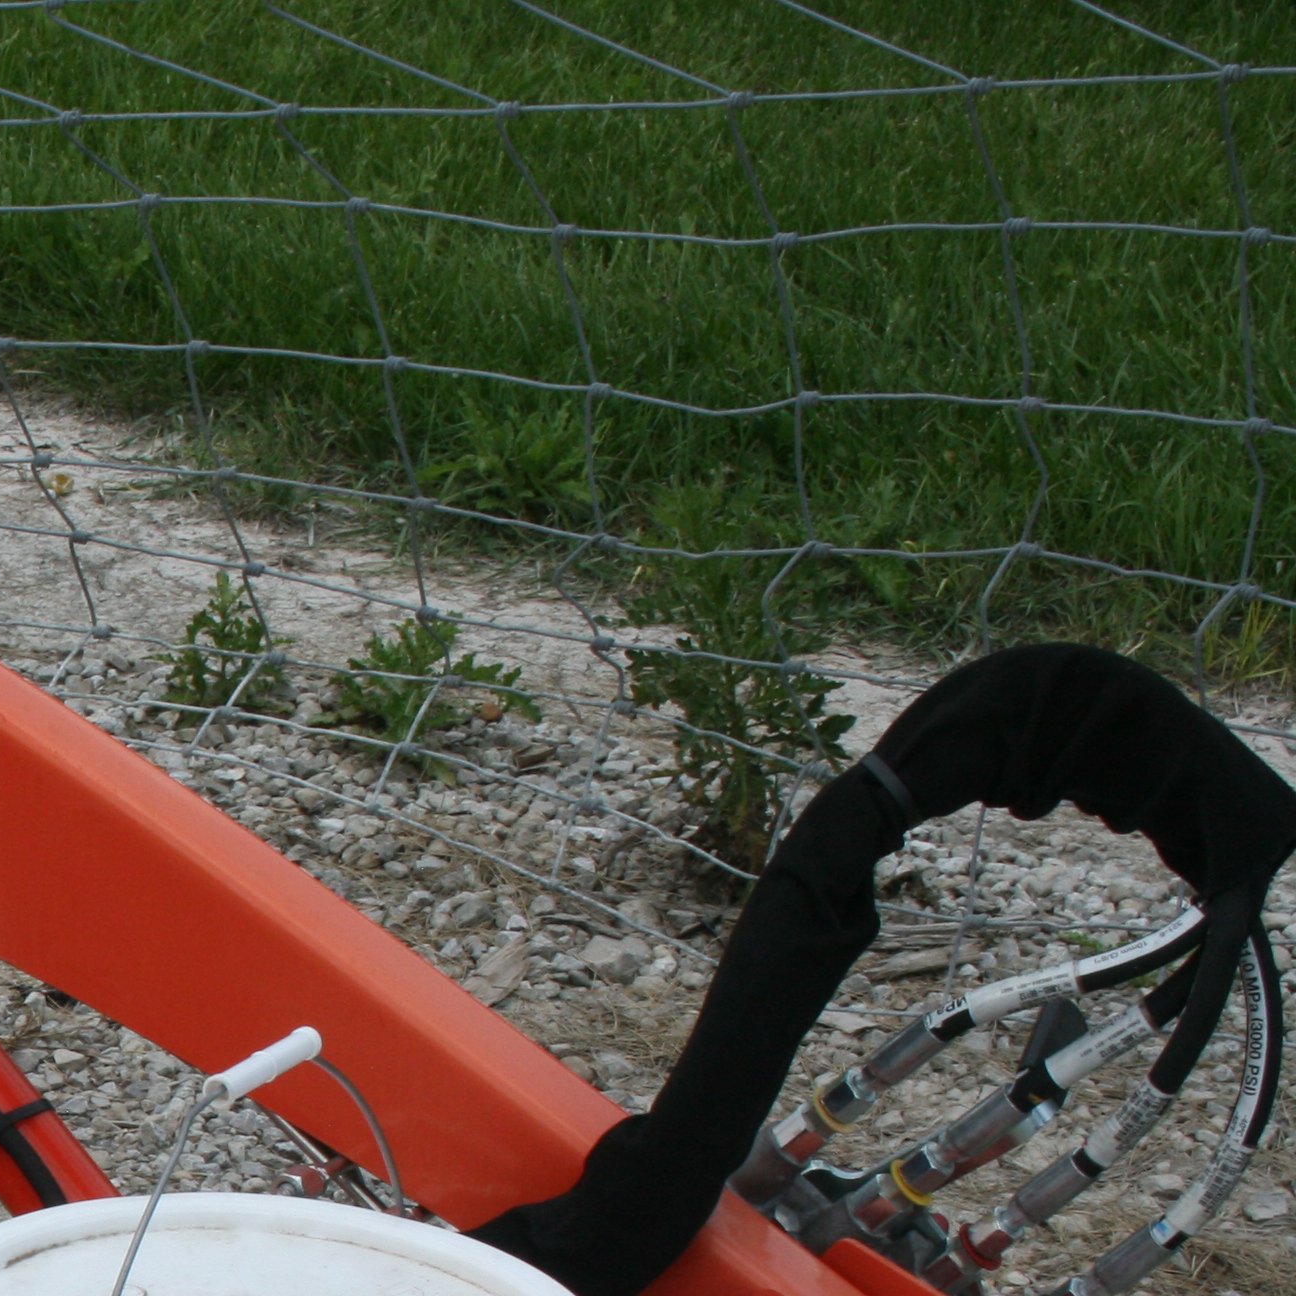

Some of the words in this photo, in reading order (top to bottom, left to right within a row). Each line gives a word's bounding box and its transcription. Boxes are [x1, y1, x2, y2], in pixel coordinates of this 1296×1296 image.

[1246, 976, 1261, 1012] MPa
[1250, 1018, 1263, 1060] (3000
[1242, 1064, 1261, 1096] PSI)
